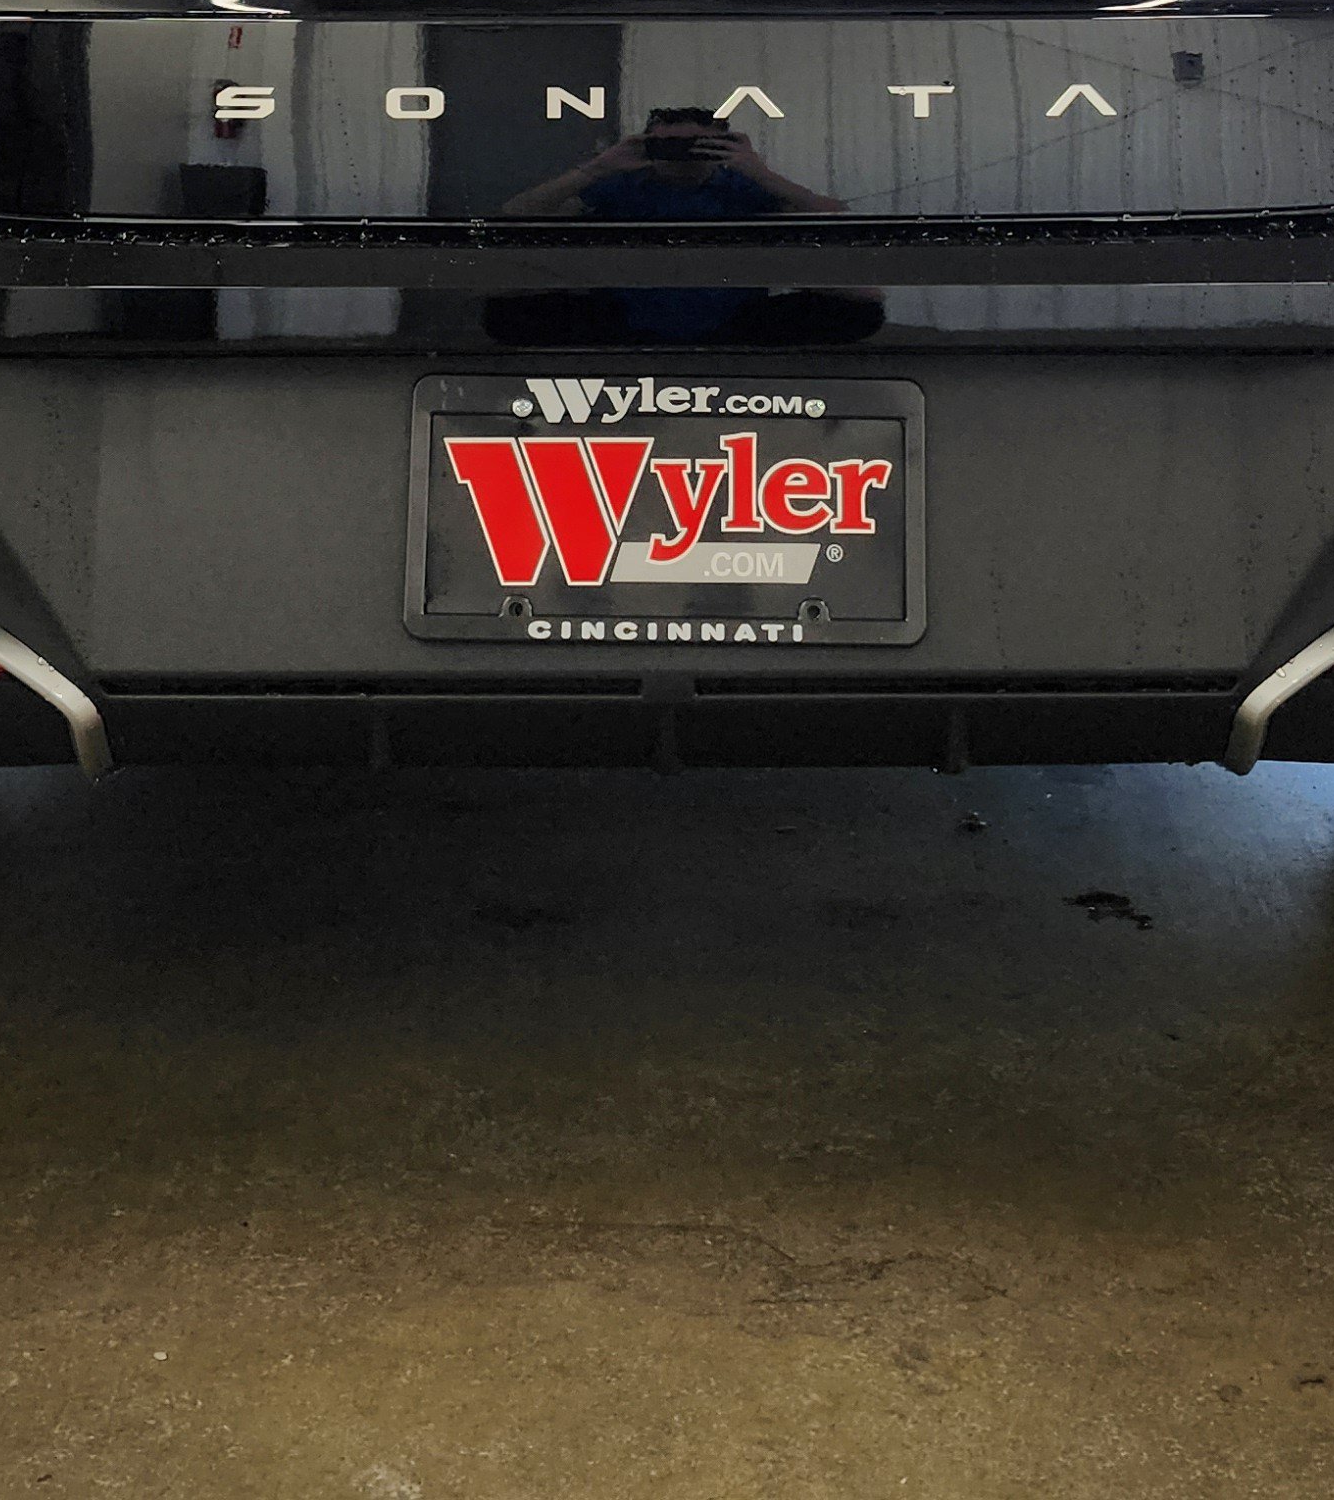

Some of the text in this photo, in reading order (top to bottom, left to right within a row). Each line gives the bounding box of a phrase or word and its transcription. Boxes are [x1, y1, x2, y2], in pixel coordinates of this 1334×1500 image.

[214, 83, 1118, 120] SONATA
[443, 432, 892, 586] Wyler
[703, 551, 785, 578] .COM
[527, 620, 804, 643] CINCINNATI
